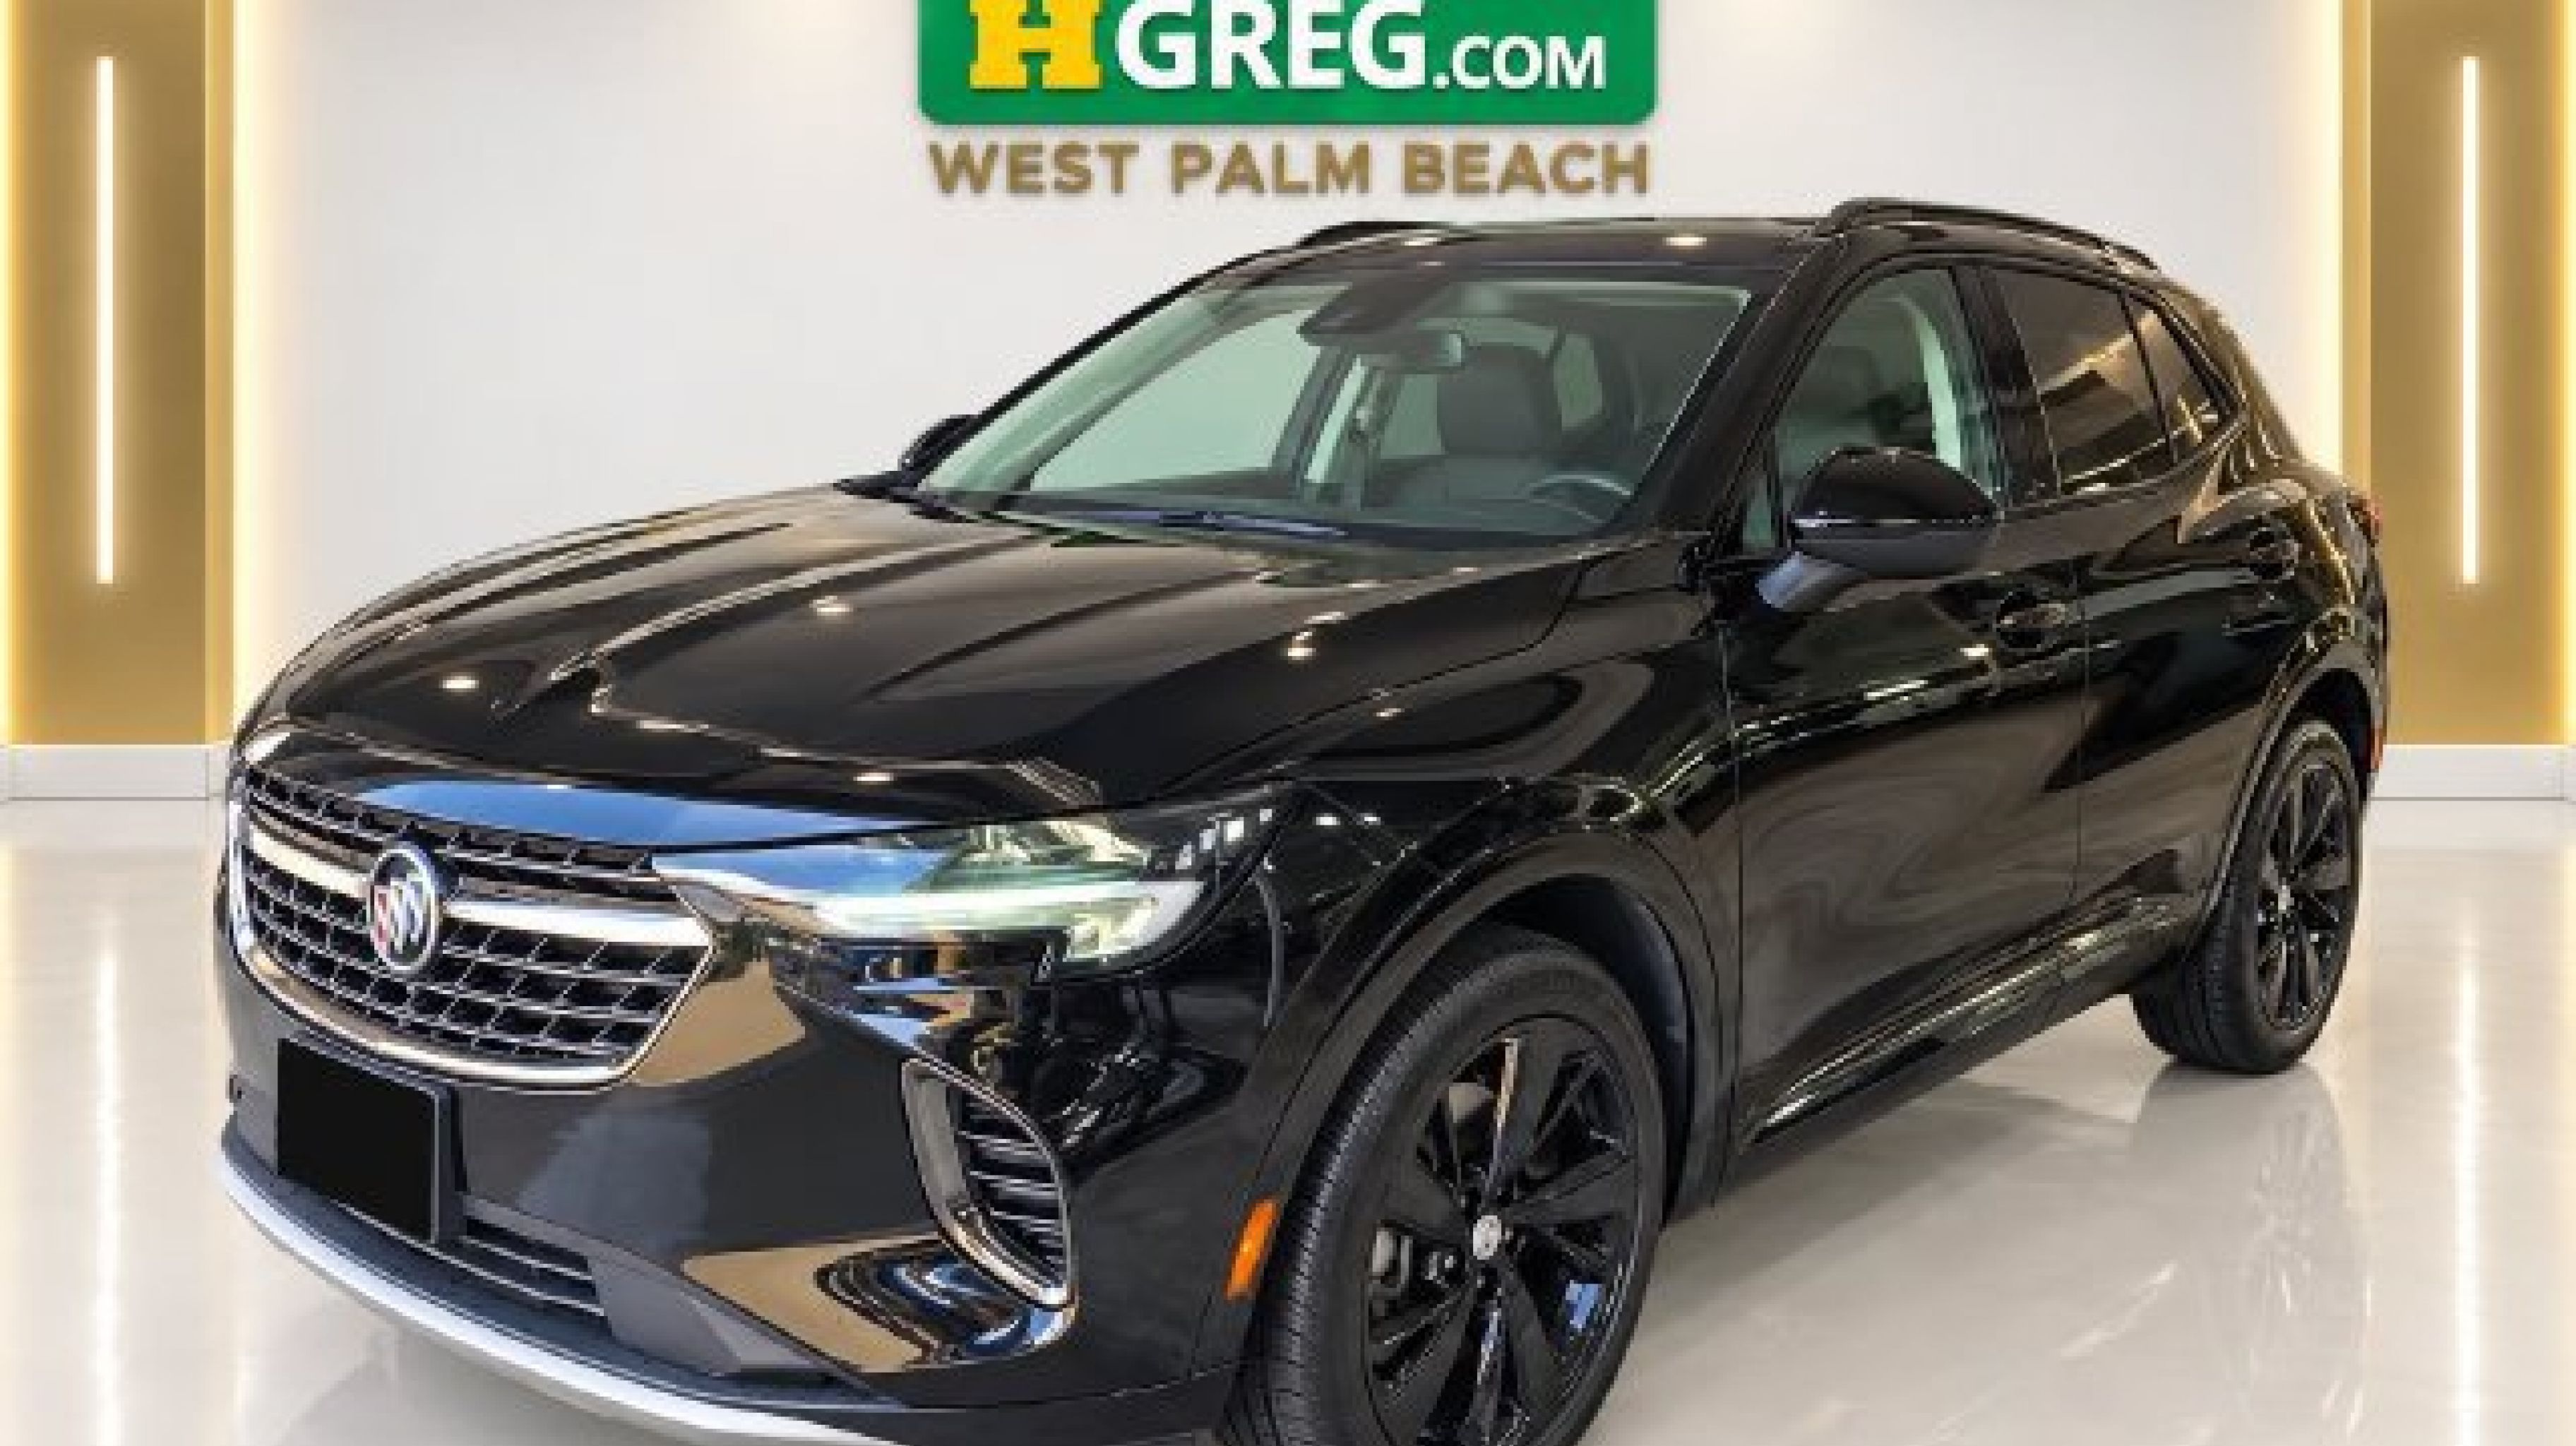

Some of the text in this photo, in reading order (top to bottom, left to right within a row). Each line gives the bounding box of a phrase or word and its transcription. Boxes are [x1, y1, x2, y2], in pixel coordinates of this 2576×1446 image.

[928, 142, 1649, 196] WEST PALM BEACH
